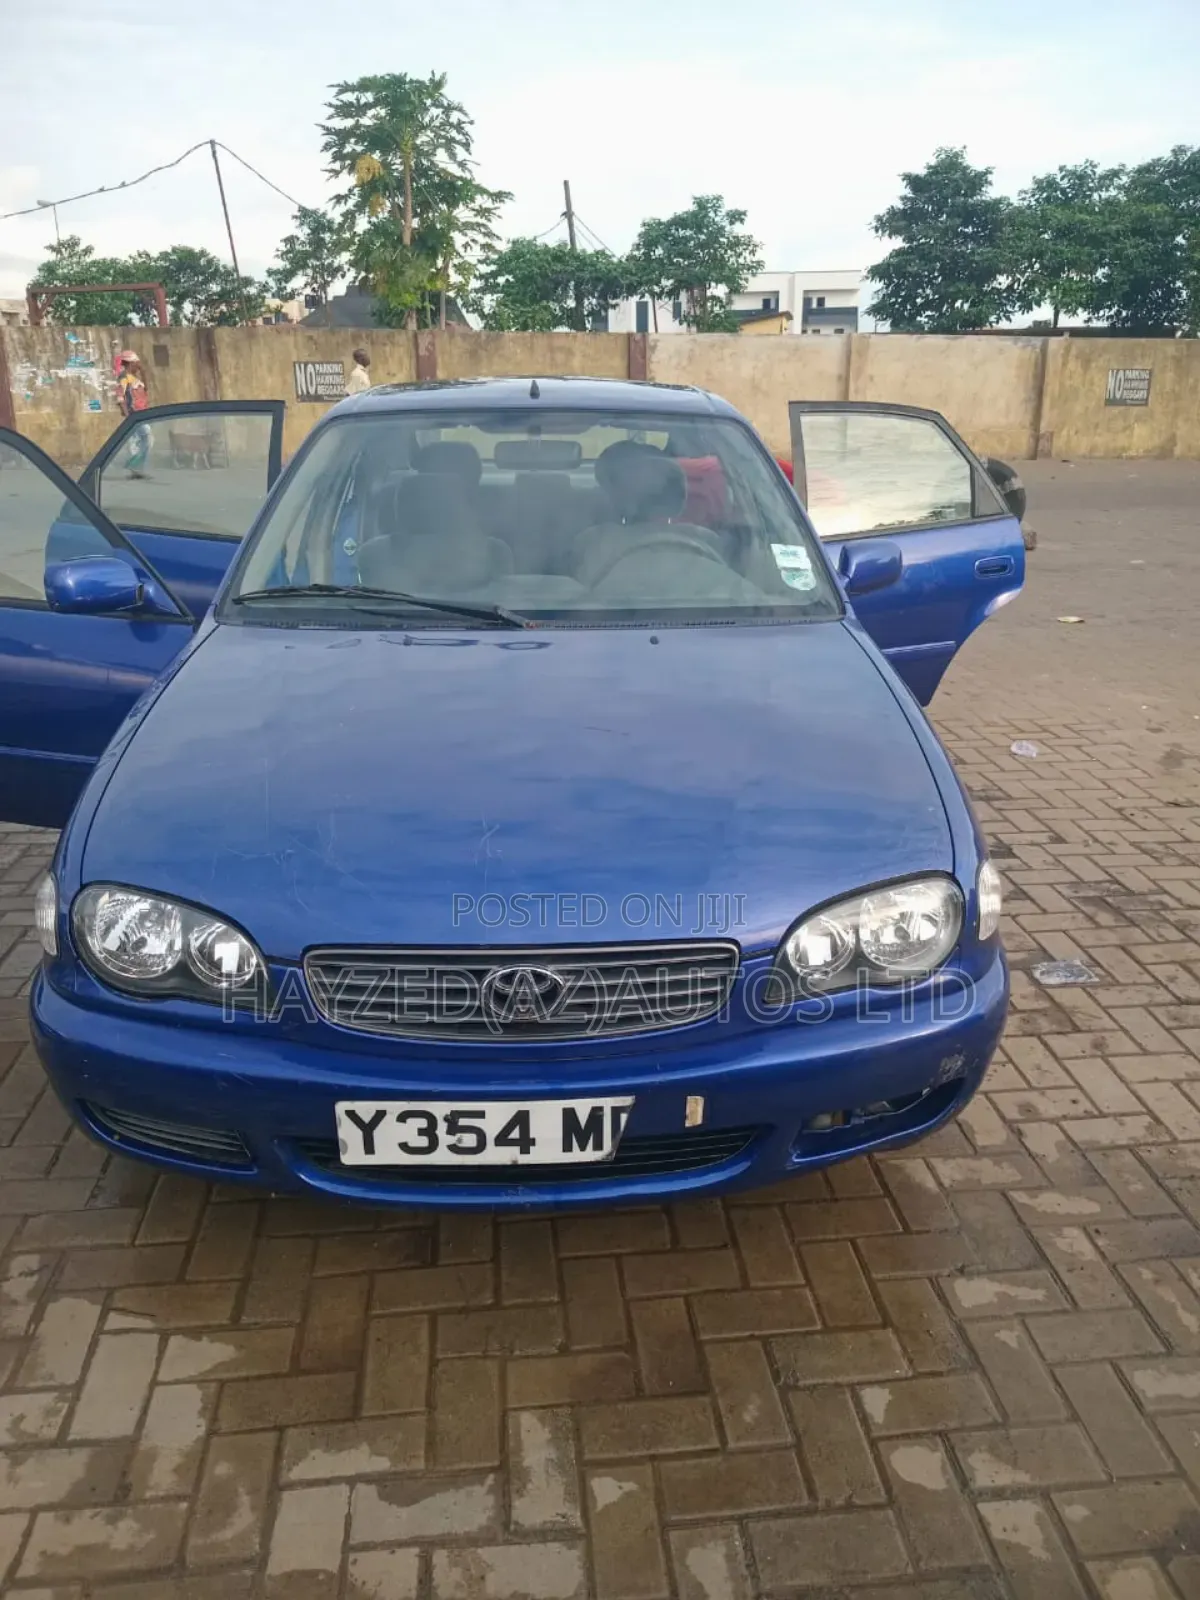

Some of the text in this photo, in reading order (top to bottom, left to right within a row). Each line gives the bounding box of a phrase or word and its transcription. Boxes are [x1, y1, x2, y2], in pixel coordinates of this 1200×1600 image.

[295, 363, 316, 396] NO
[315, 363, 343, 373] PARKING
[1106, 369, 1124, 400] NO
[344, 1109, 536, 1155] Y354
